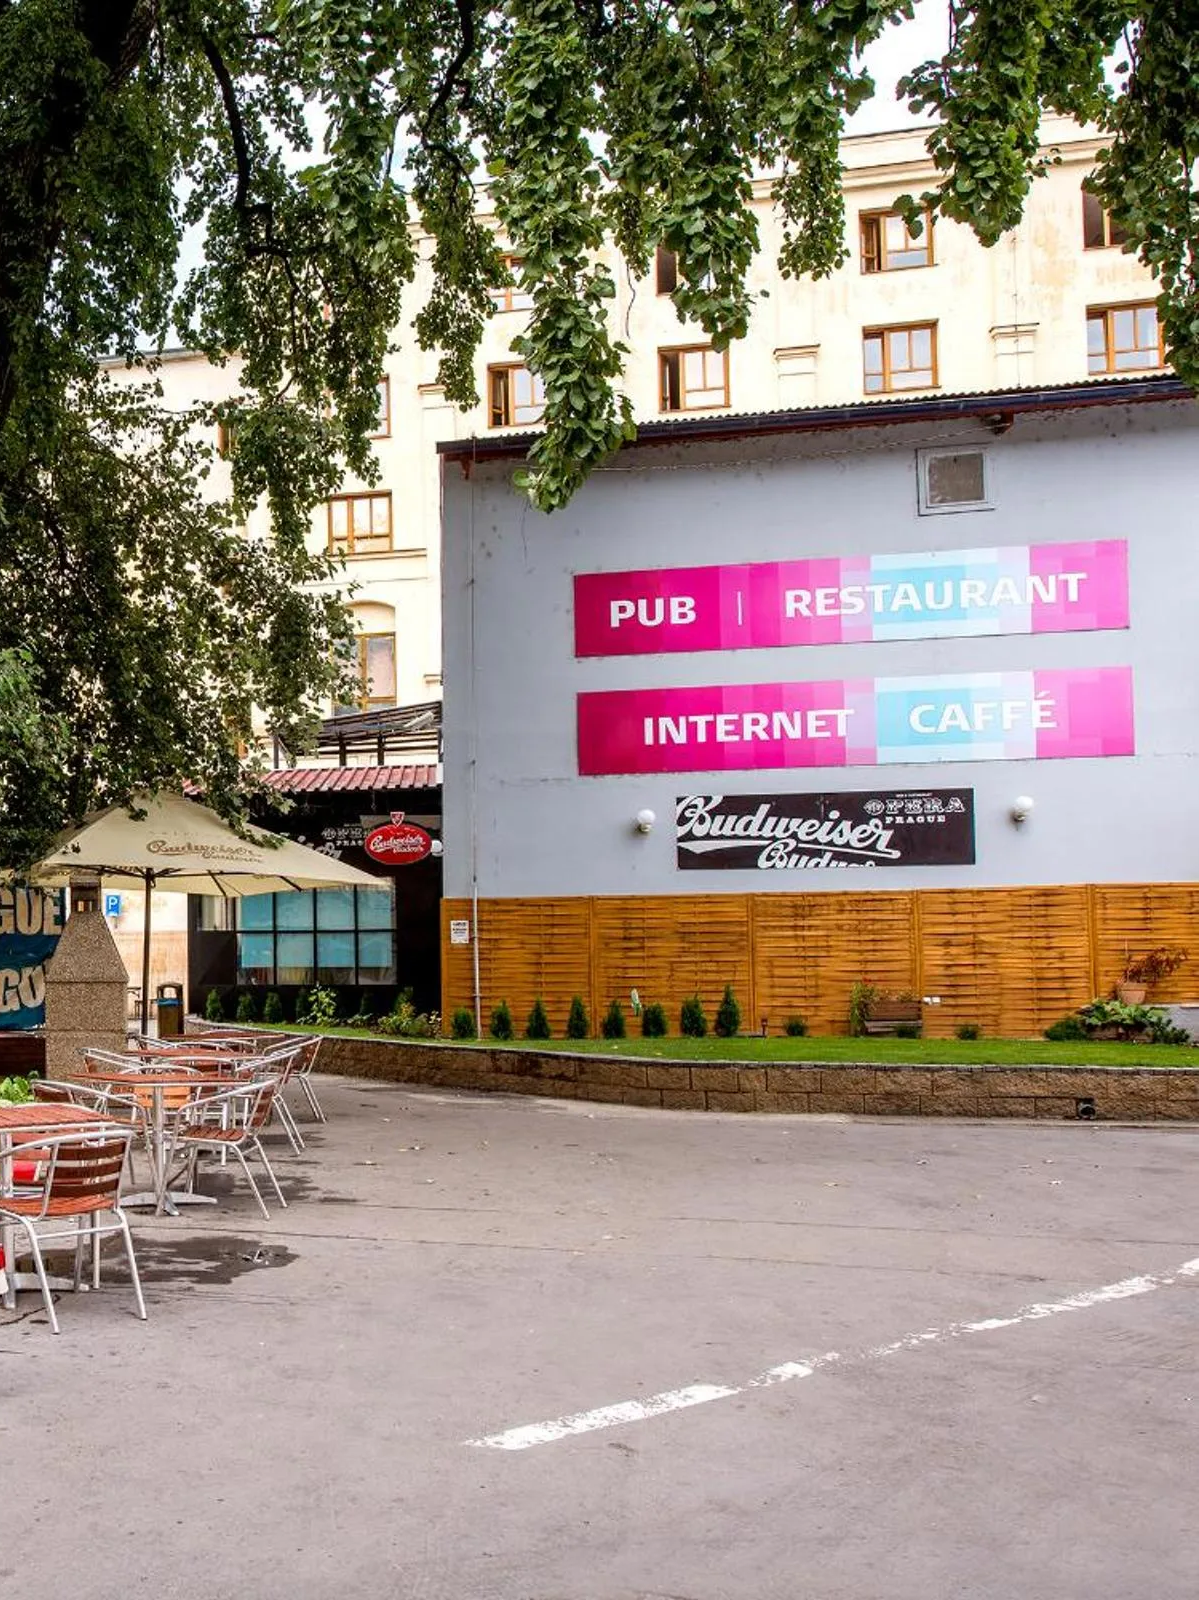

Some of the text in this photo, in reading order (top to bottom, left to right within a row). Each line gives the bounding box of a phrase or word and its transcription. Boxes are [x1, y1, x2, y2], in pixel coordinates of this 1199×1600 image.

[609, 571, 1088, 629] PUB RESTAURANT
[642, 691, 1058, 746] INTERNET CAFFÉ
[676, 795, 900, 858] Budweiser
[885, 814, 946, 824] PRAGUE
[108, 896, 118, 910] P
